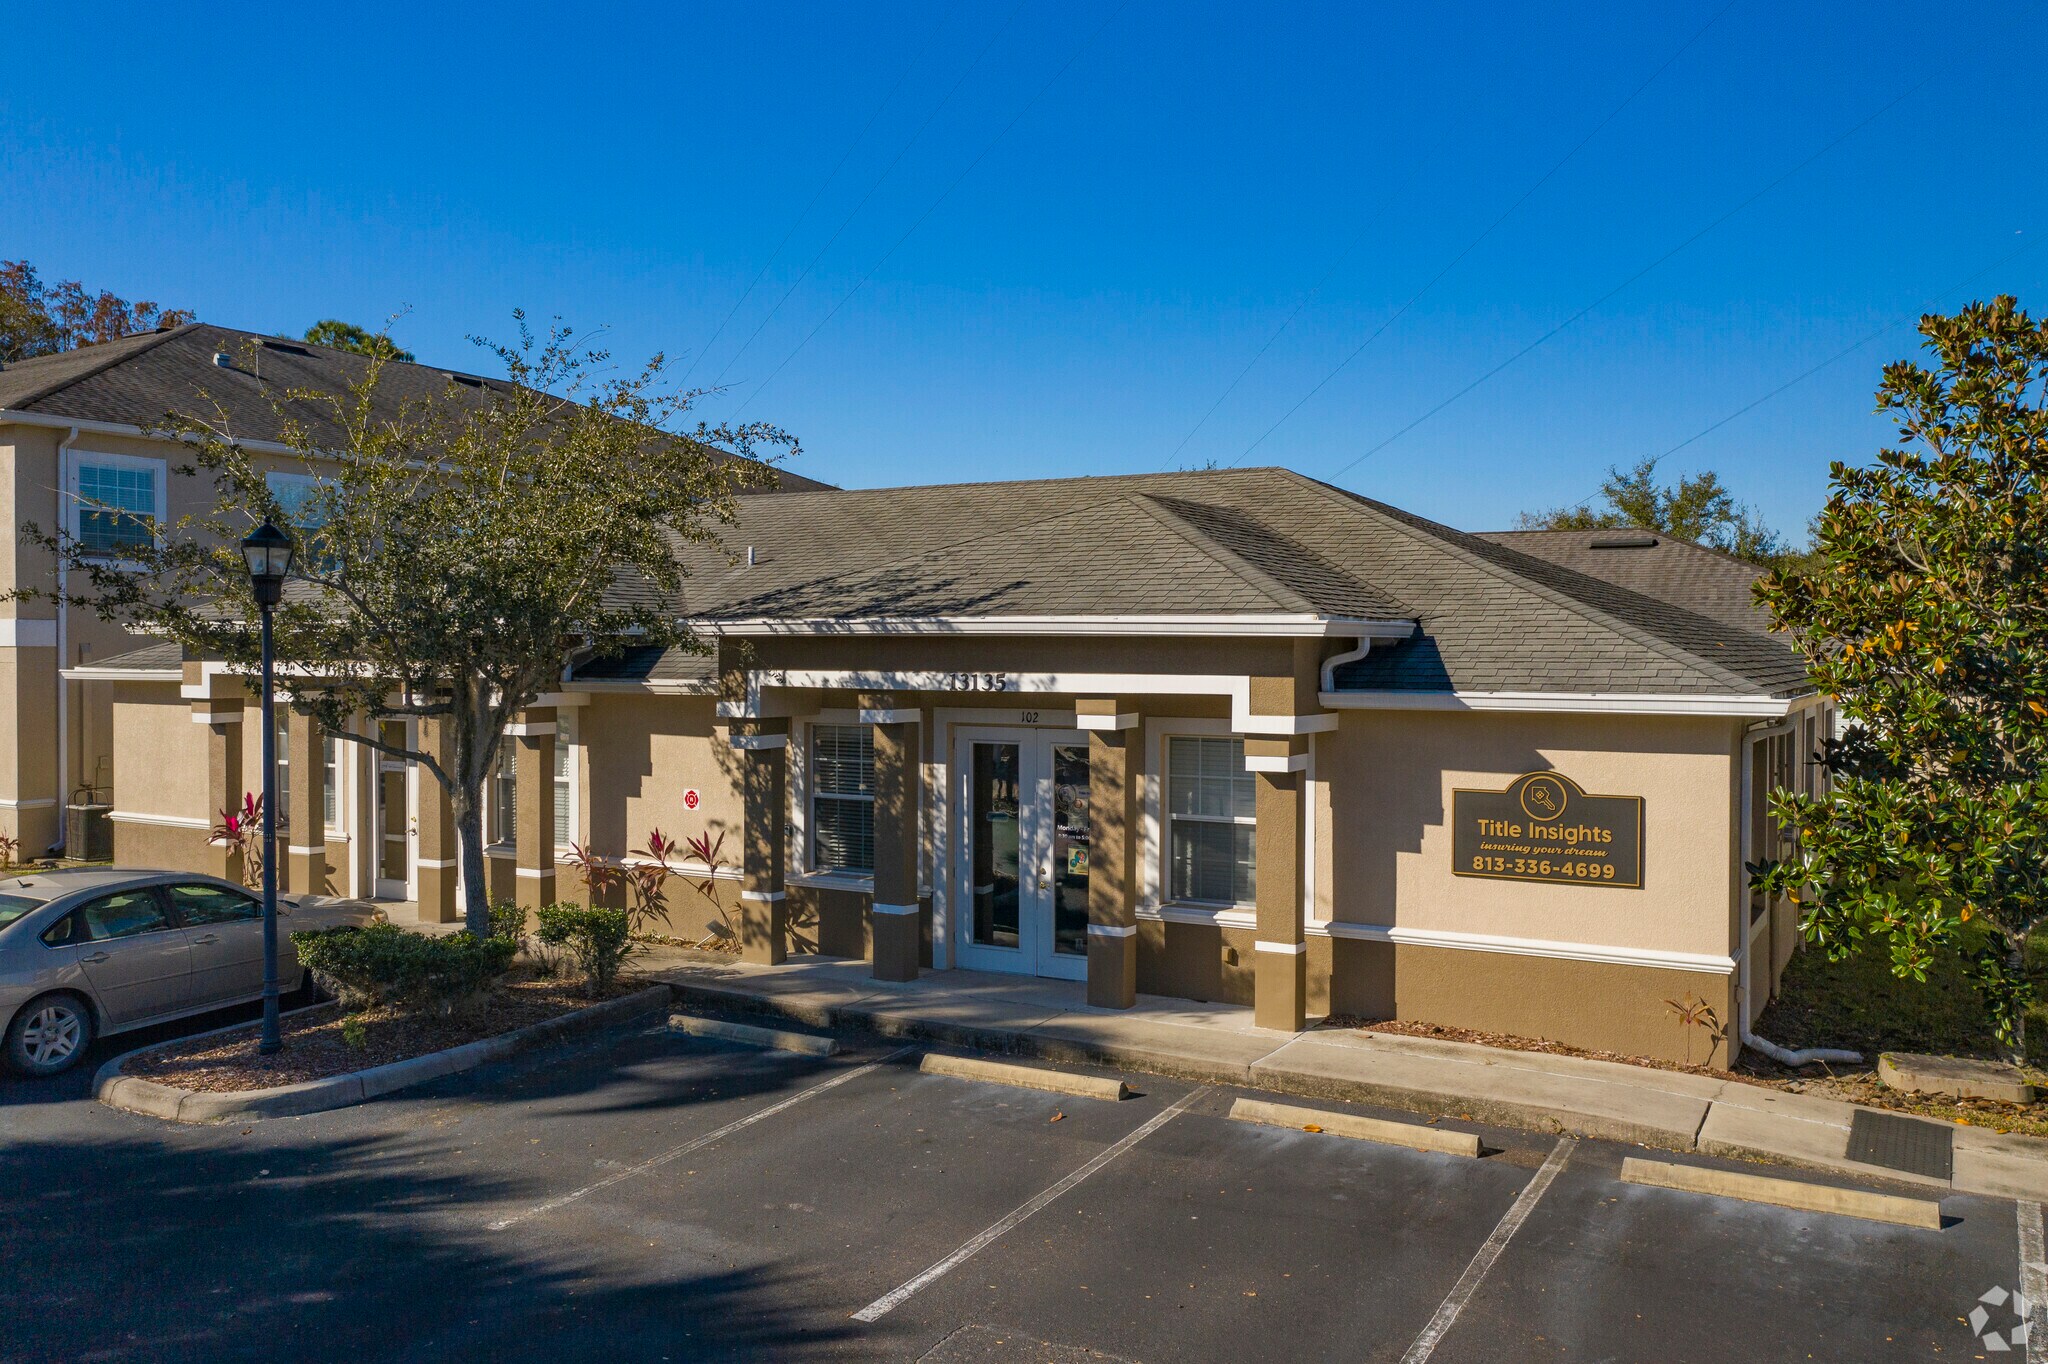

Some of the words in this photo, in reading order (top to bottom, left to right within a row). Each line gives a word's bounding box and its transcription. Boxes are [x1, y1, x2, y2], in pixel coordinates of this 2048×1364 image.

[949, 672, 1007, 692] 13135
[1021, 711, 1039, 723] 102
[1056, 824, 1079, 833] Monday
[1477, 818, 1522, 838] Title
[1528, 822, 1613, 845] Insights
[1480, 841, 1531, 855] insuring
[1532, 845, 1564, 855] your
[1564, 847, 1609, 857] dream
[1472, 855, 1616, 879] 813-336-4699
